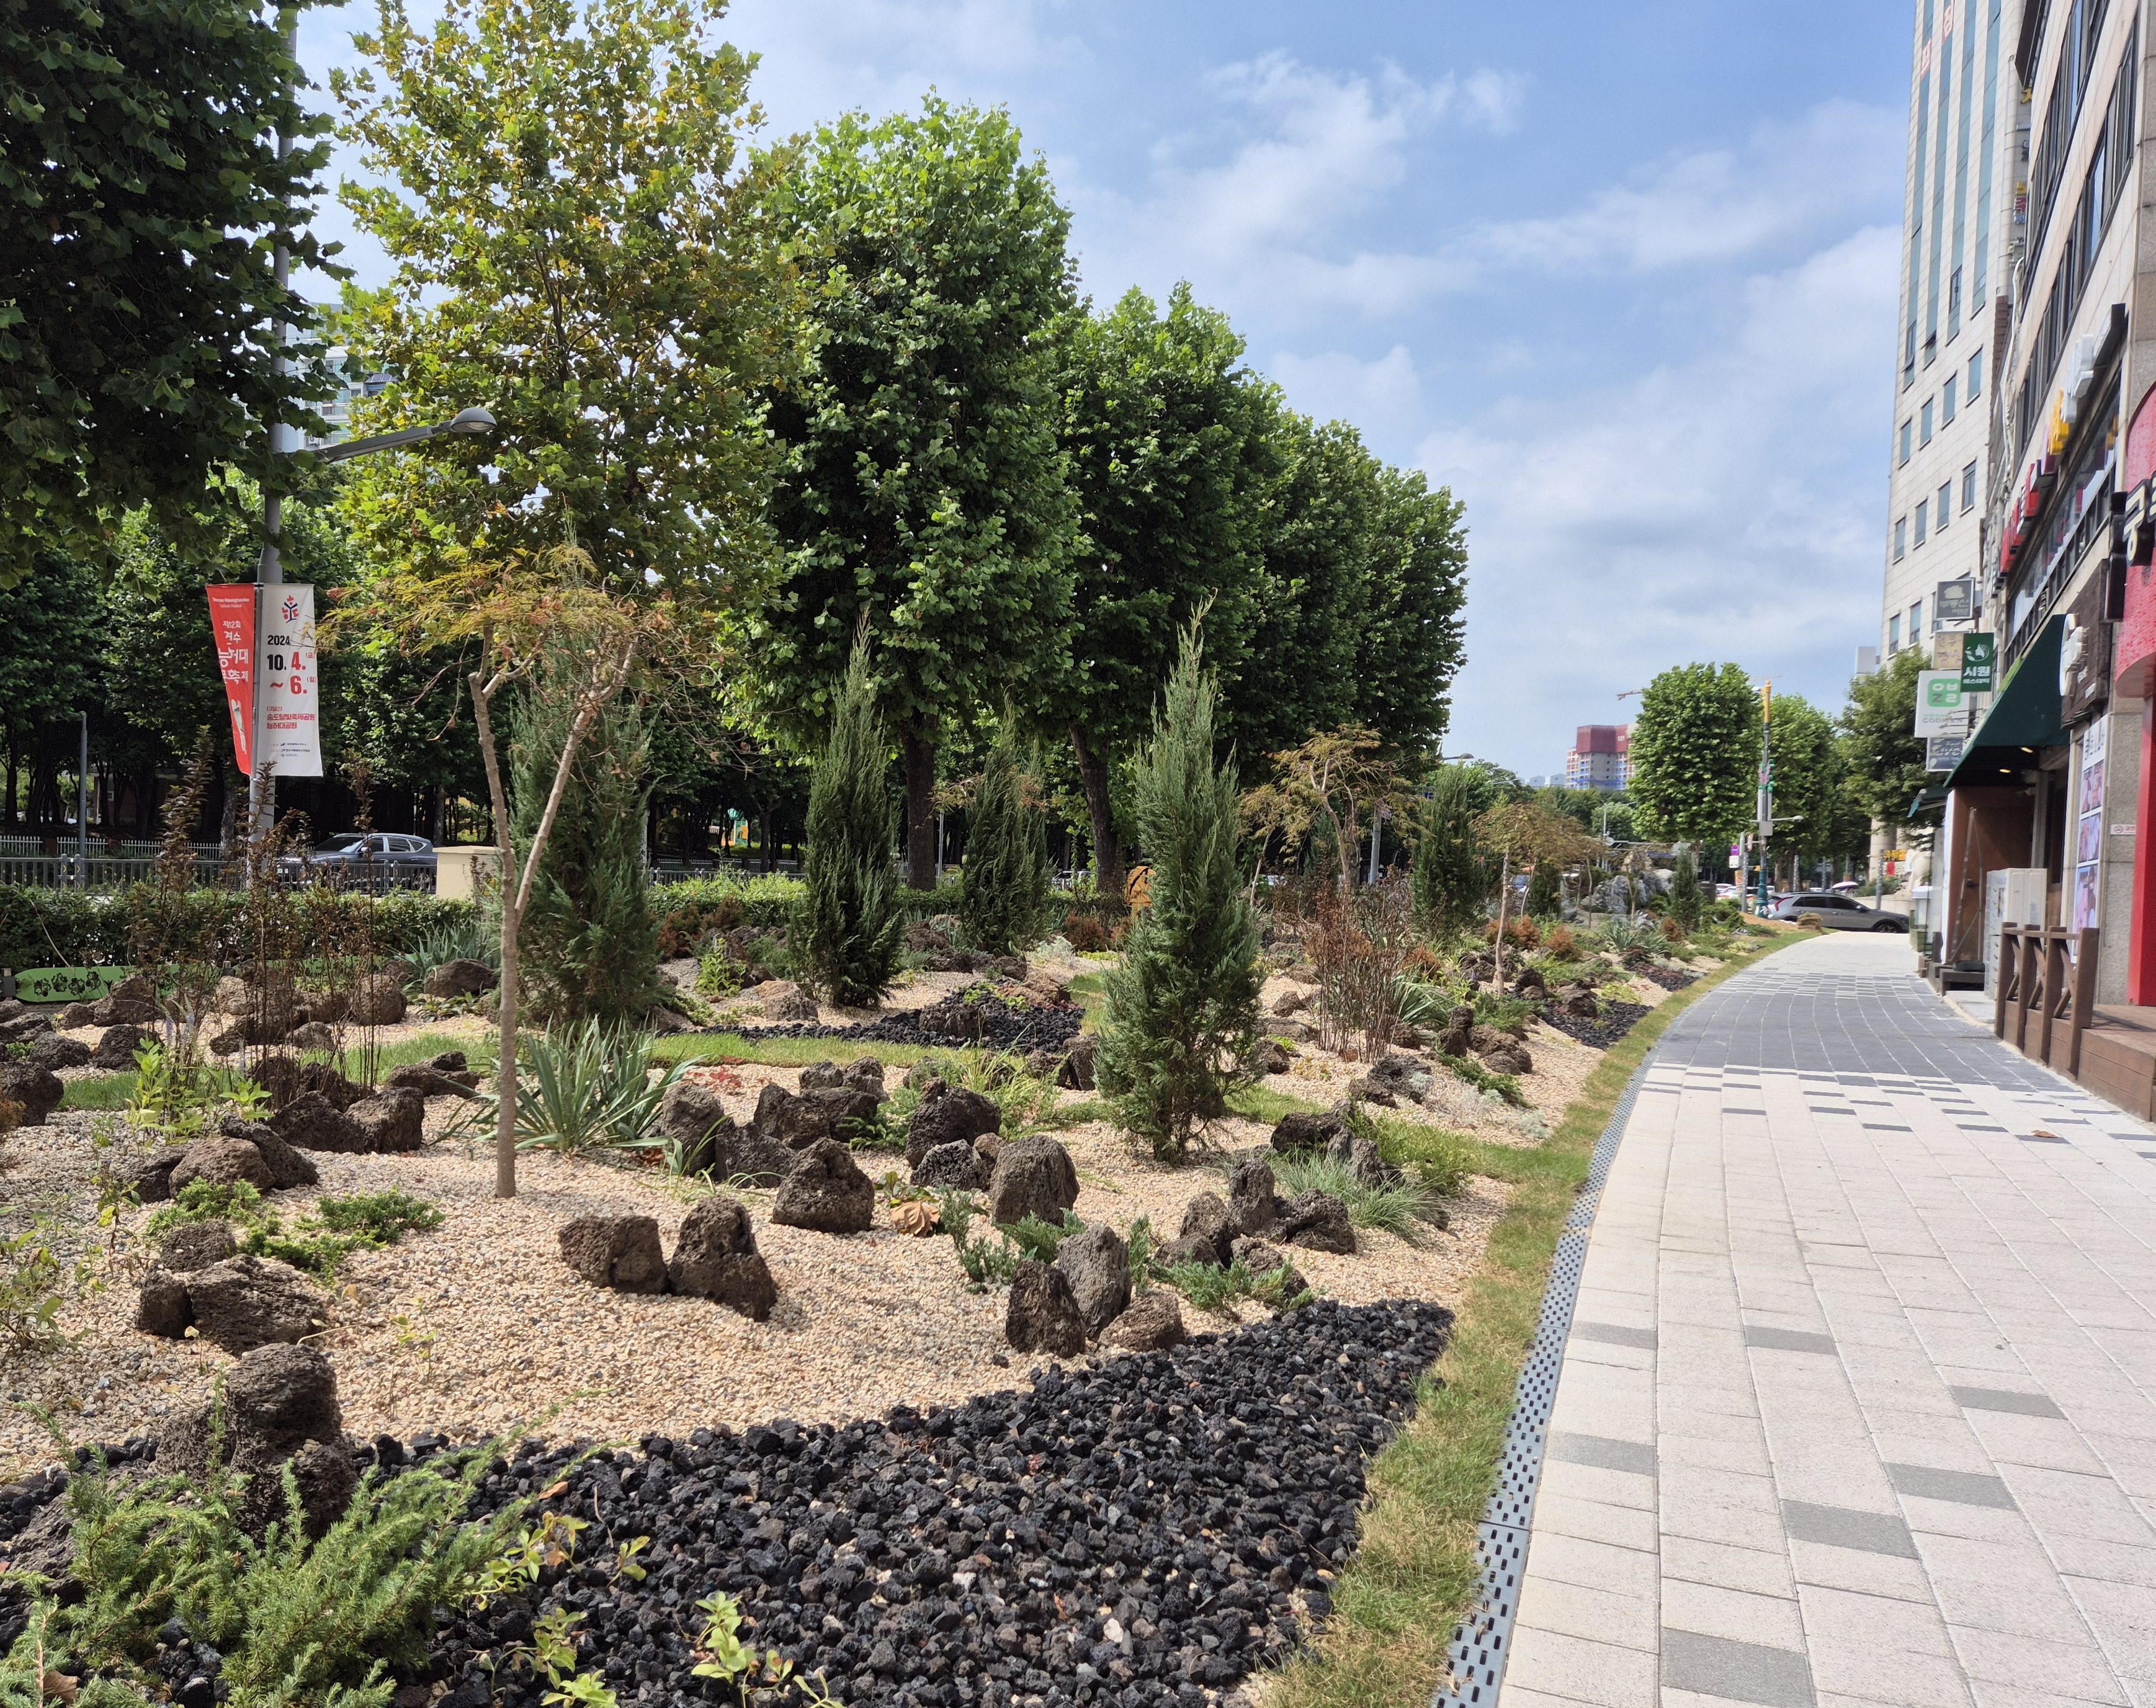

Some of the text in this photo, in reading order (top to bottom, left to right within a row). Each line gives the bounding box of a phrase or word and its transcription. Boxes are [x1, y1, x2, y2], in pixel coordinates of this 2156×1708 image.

[1939, 599, 1969, 609] 부동산
[222, 620, 241, 628] 제12회
[267, 635, 290, 646] 2024
[267, 654, 287, 671] 10.
[291, 651, 306, 671] 4.
[1963, 666, 1990, 677] 시원
[290, 675, 308, 695] 6.
